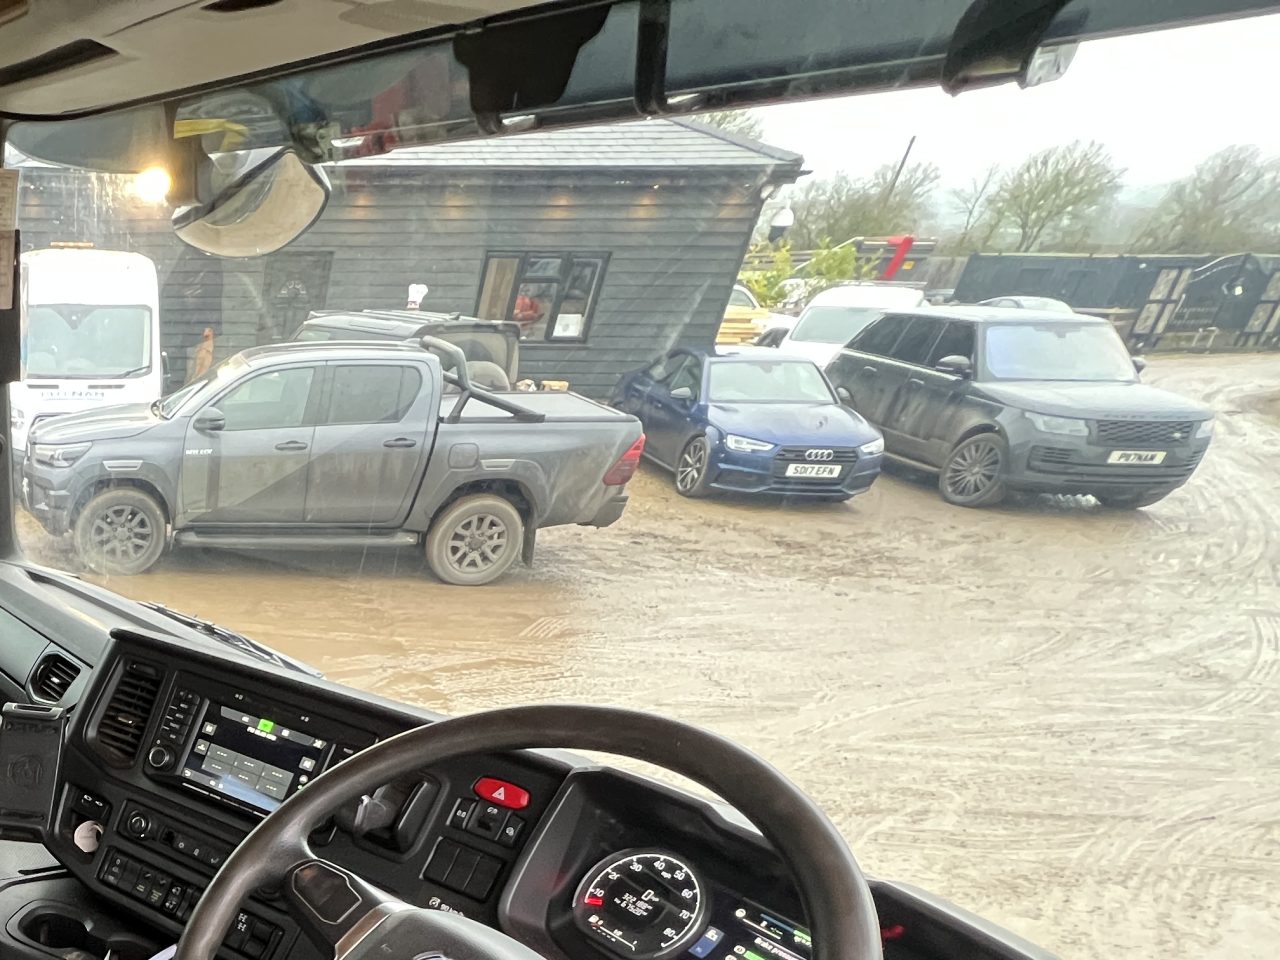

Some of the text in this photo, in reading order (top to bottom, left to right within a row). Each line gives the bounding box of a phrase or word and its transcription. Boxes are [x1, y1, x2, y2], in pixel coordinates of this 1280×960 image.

[630, 862, 643, 872] 30
[653, 860, 666, 870] 40
[594, 887, 605, 897] 10
[679, 909, 690, 919] 70
